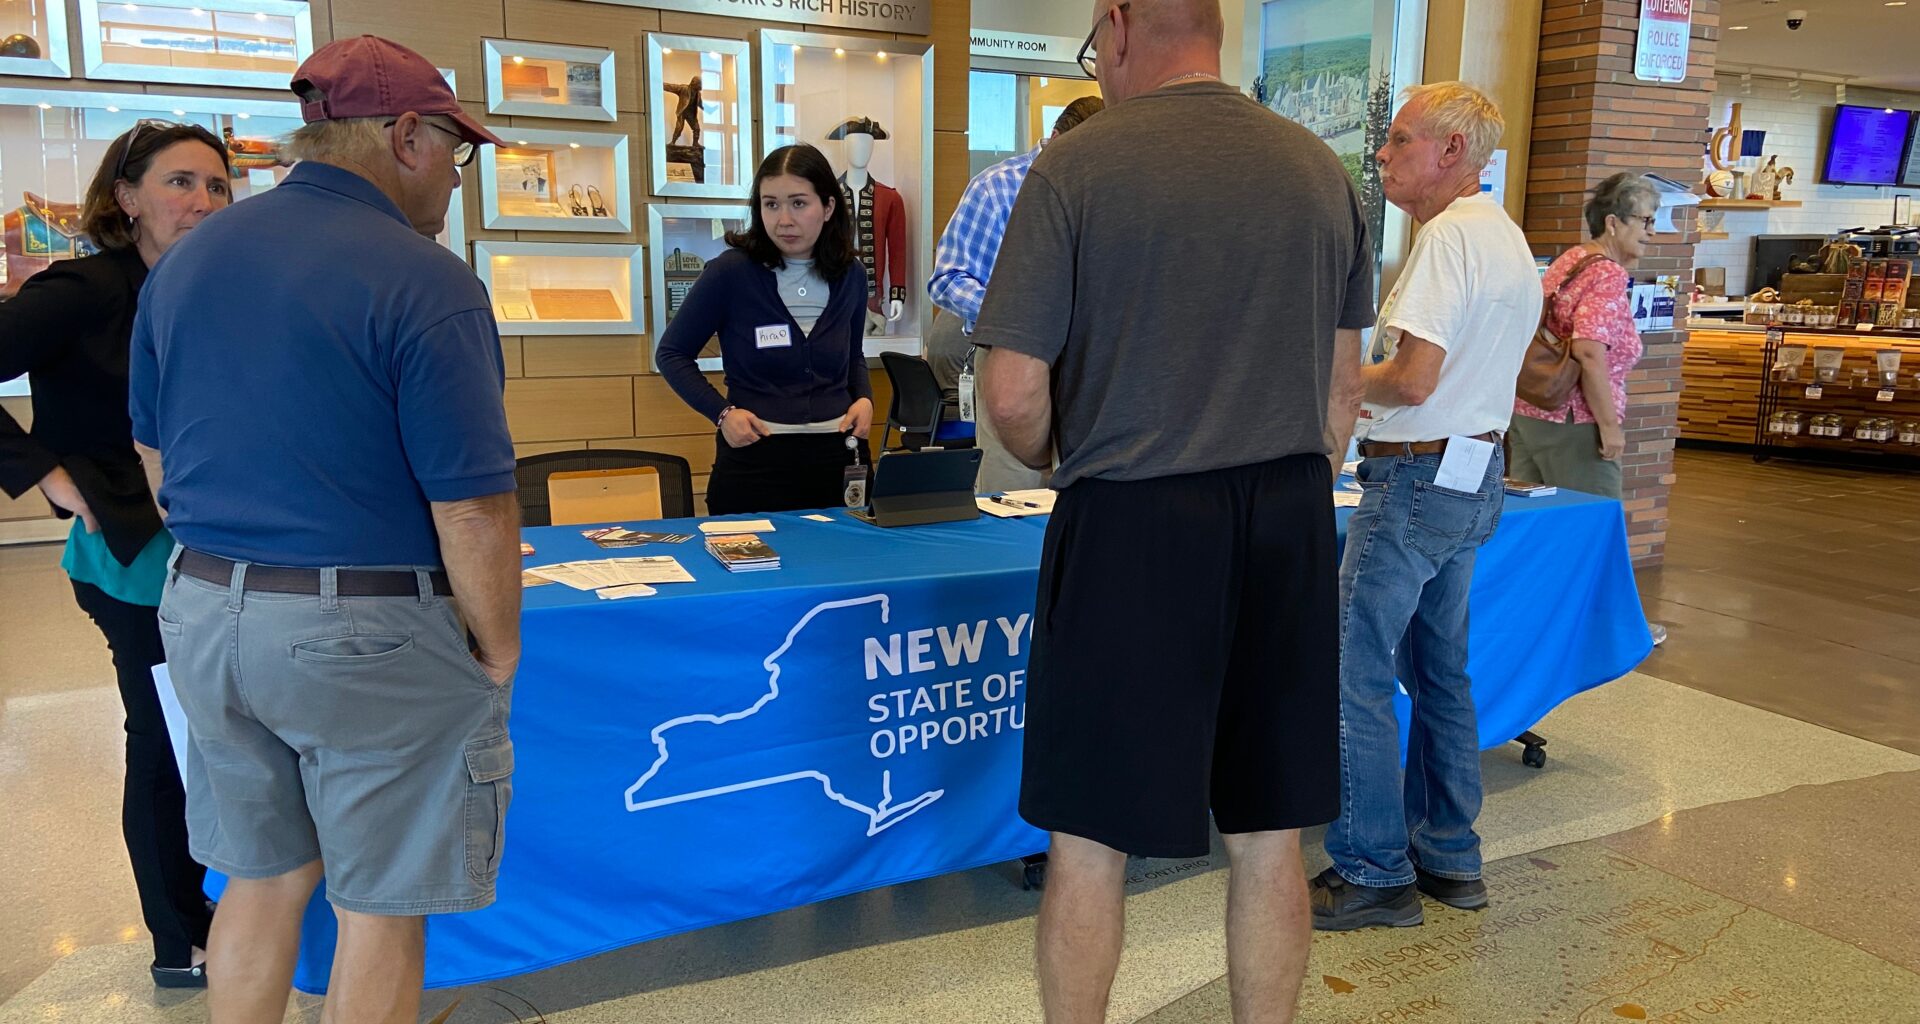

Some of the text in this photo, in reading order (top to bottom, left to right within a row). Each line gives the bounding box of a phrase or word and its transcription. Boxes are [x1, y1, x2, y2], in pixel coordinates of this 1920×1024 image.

[789, 0, 834, 13] RICH
[838, 1, 917, 21] HISTORY
[1017, 41, 1047, 52] ROOM
[1647, 31, 1680, 47] POLICE
[1640, 53, 1683, 70] ENFORCED
[864, 613, 1035, 681] NEW Y
[868, 669, 1025, 723] STATE OF
[1144, 860, 1210, 880] ONTARIO
[1489, 873, 1553, 894] PARK
[1576, 896, 1671, 928] NIAGARA
[1654, 902, 1718, 921] TRAIL
[1343, 903, 1574, 976] WILSON-TUSCARORA
[1367, 939, 1512, 989] STATE PARK
[1377, 995, 1451, 1024] PARK
[1695, 986, 1764, 1014] CAVE
